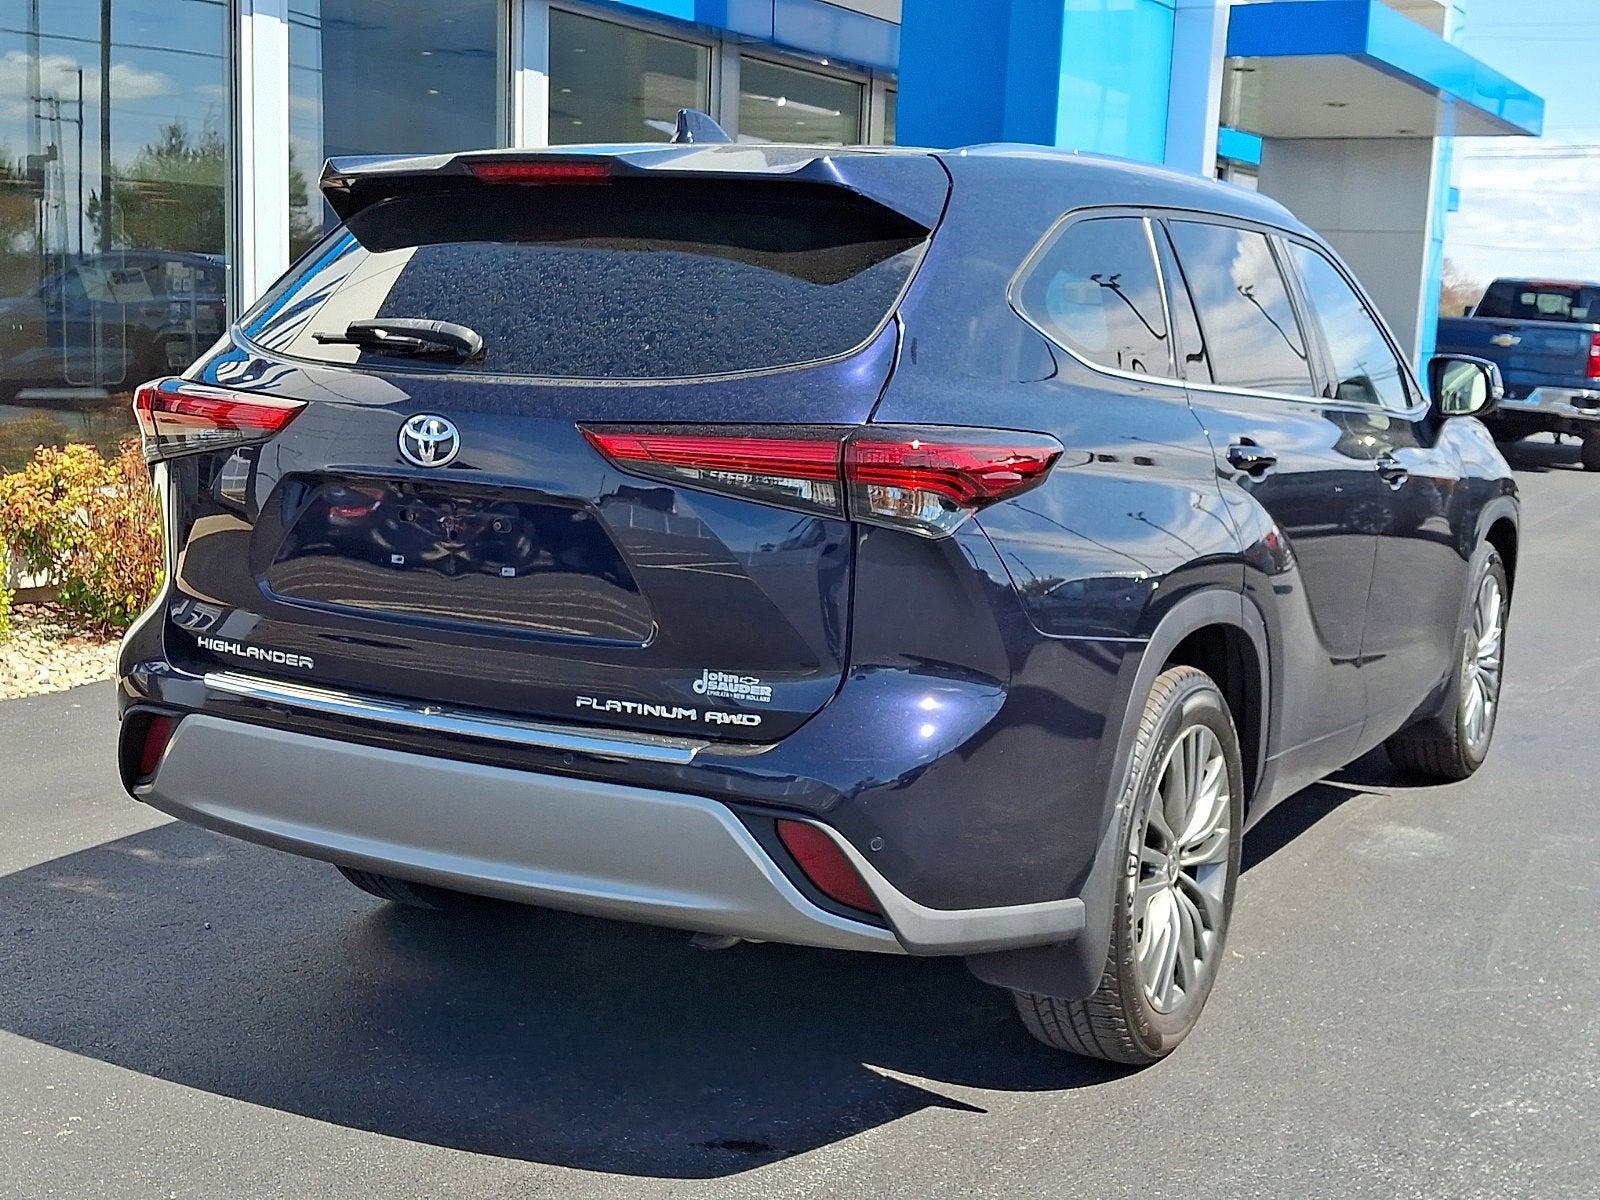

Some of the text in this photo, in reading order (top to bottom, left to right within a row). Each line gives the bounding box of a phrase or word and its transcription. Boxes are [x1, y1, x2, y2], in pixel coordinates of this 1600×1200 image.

[197, 636, 315, 670] HIGHLANDER
[707, 681, 772, 697] SAUDER
[707, 690, 730, 698] EPHRATA
[746, 695, 771, 703] HOLLAND
[575, 696, 762, 726] PLATINUM AWD
